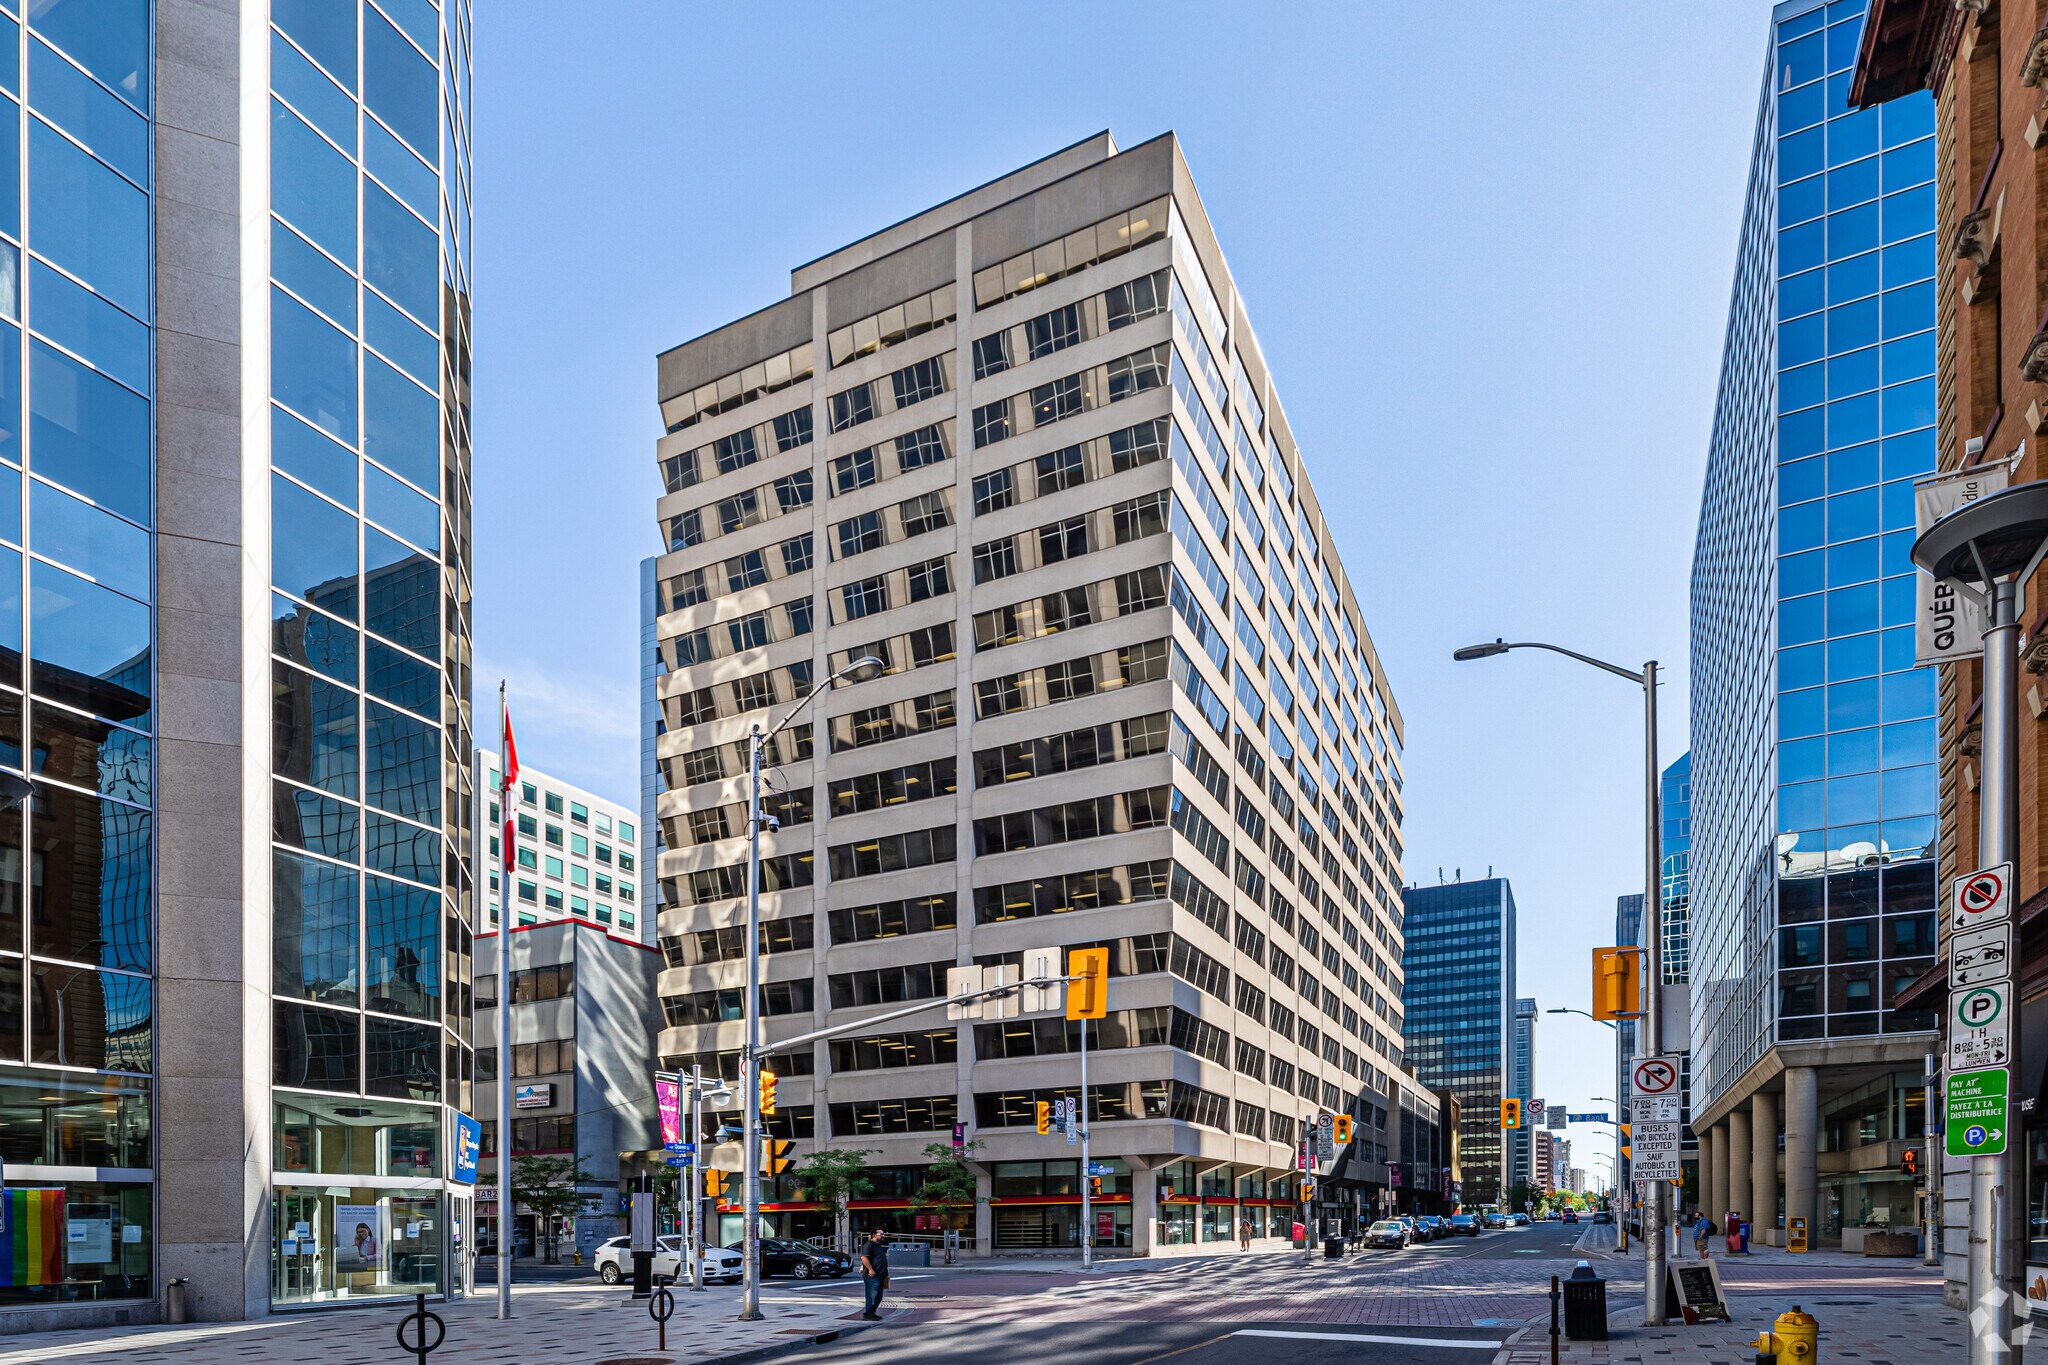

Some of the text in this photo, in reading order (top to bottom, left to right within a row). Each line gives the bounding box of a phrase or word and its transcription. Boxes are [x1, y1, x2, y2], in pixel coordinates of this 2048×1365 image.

[1962, 482, 1978, 506] dia
[1972, 998, 1991, 1019] P
[1980, 1028, 1986, 1038] H
[1951, 1088, 1982, 1097] MACHINE
[1950, 1102, 1972, 1111] PAYEZ
[1950, 1108, 2002, 1119] DISTRIBUTRICE
[1641, 1124, 1668, 1133] BUSES
[1649, 1133, 1676, 1141] BICYCLES
[1638, 1142, 1672, 1150] EXCEPTED
[1635, 1162, 1665, 1170] AUTOBUS
[1634, 1170, 1677, 1179] BICYCLETTES
